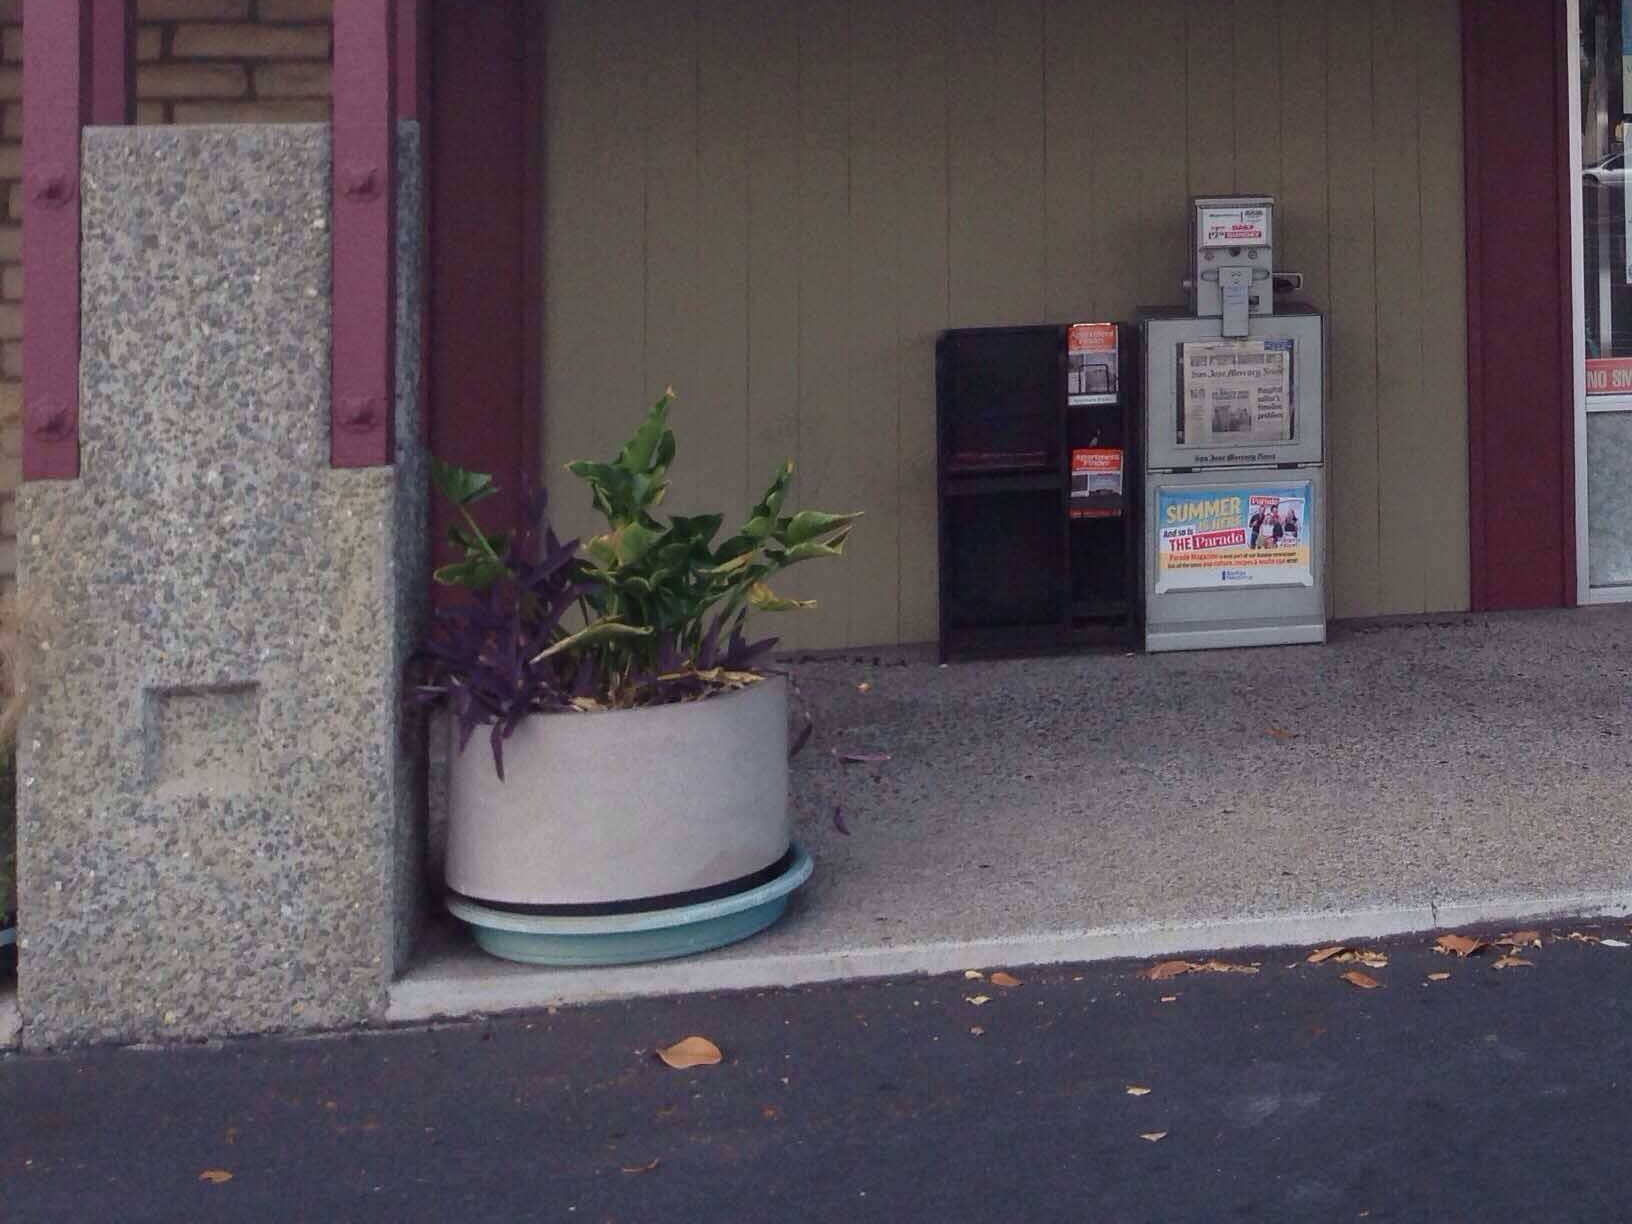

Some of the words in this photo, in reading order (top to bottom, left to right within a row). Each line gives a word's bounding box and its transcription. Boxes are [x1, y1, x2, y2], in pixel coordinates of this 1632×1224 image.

[1586, 370, 1608, 389] NO
[1166, 496, 1242, 524] SUMMER
[1163, 528, 1178, 538] And
[1179, 528, 1187, 537] so
[1169, 537, 1193, 552] THE
[1194, 531, 1245, 549] Parade
